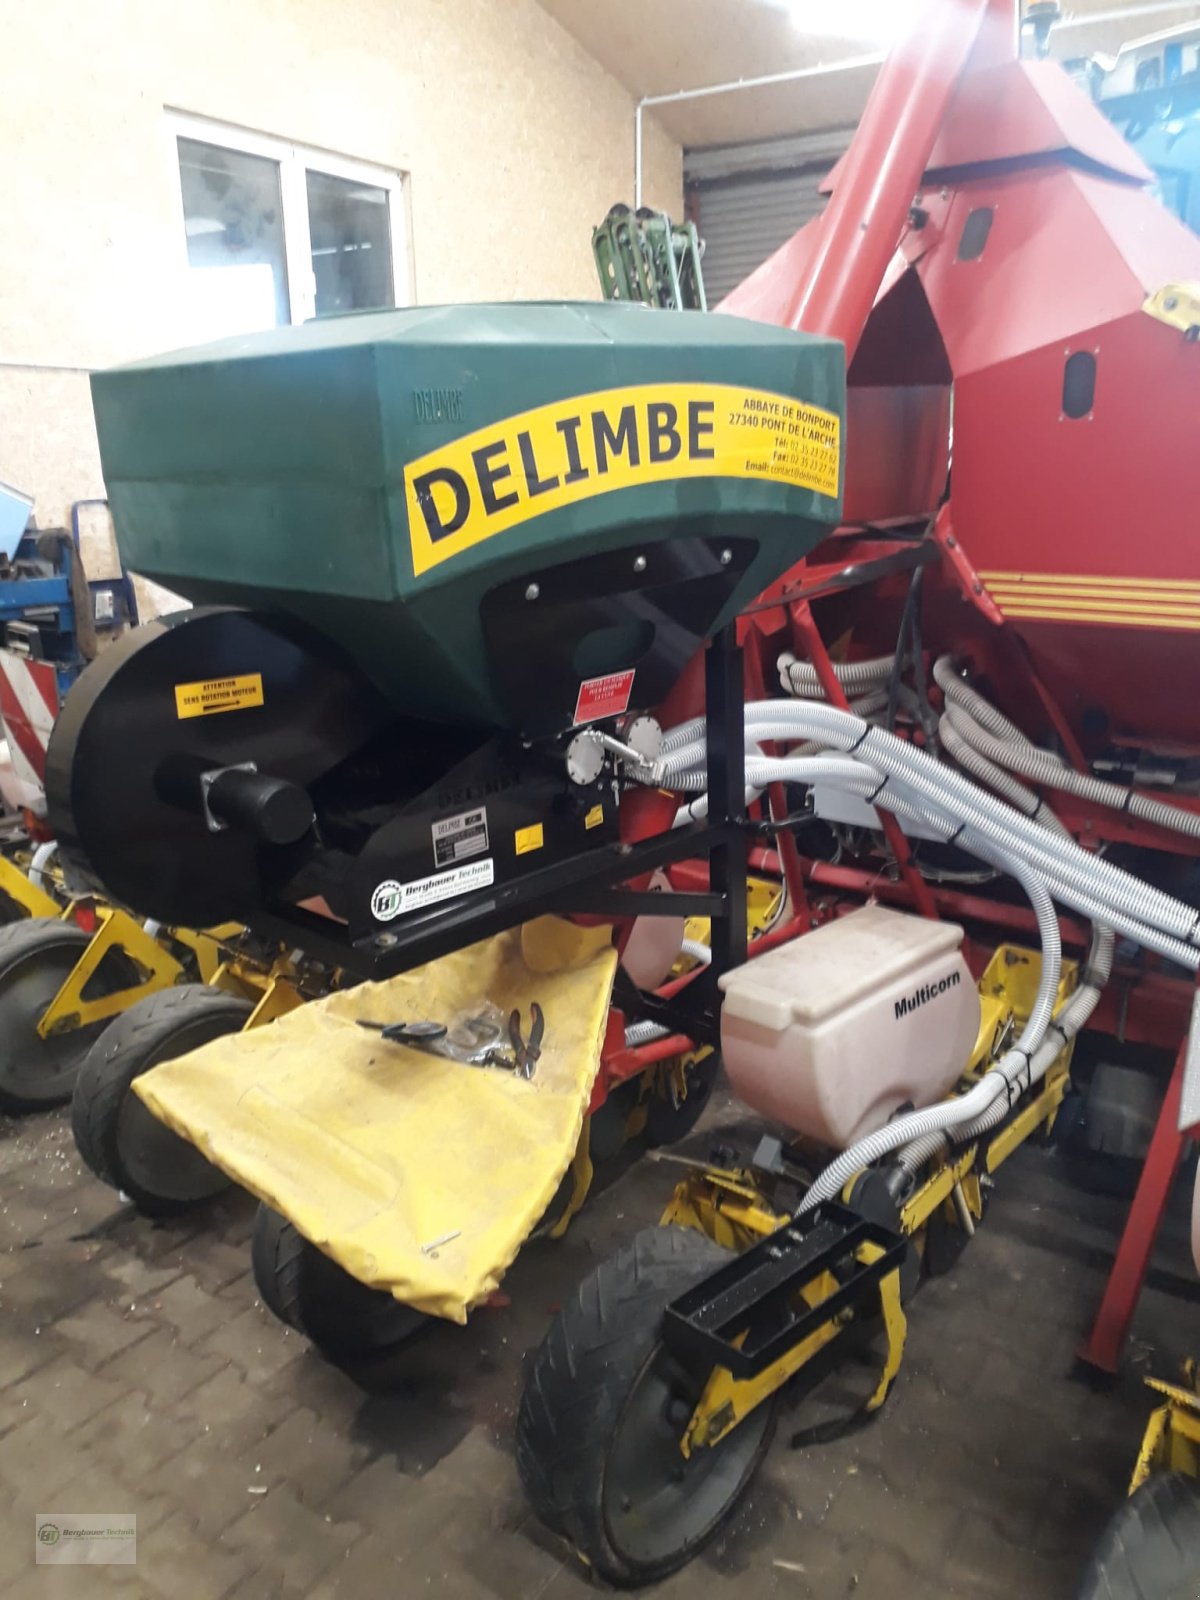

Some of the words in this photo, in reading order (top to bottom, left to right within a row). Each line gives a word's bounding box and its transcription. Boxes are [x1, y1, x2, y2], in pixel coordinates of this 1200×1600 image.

[729, 413, 758, 427] 27340
[761, 418, 786, 432] PONT
[788, 424, 800, 436] DE
[802, 429, 836, 447] L'ARCHE
[743, 398, 779, 415] ABBAYE
[782, 406, 793, 418] DE
[796, 409, 836, 432] BONPORT
[413, 400, 714, 545] DELIMBE
[745, 460, 769, 473] Email:
[773, 450, 789, 463] Fax:
[183, 695, 199, 705] SENS
[201, 691, 230, 702] ROTATION
[232, 686, 257, 697] MOTEUR
[203, 680, 236, 691] ATTENTION
[405, 874, 456, 896] Bergbauer
[458, 862, 491, 879] Technik
[894, 971, 961, 1020] Multicorn
